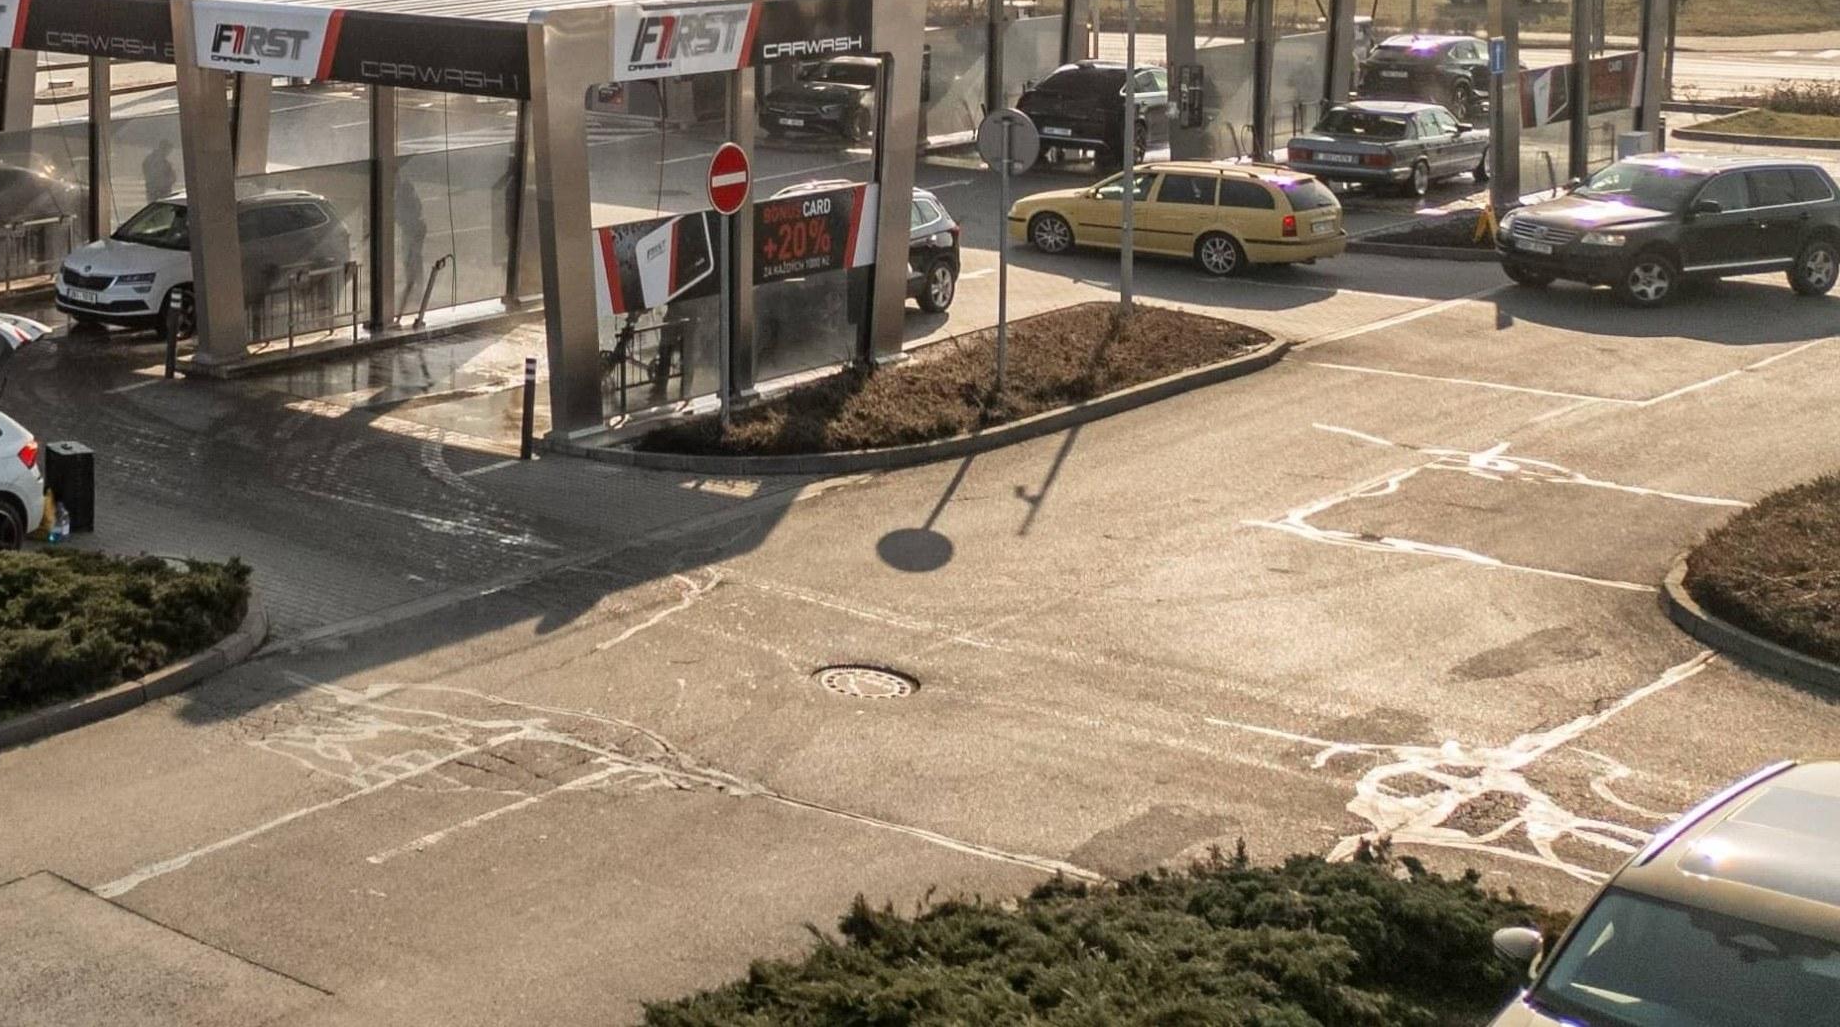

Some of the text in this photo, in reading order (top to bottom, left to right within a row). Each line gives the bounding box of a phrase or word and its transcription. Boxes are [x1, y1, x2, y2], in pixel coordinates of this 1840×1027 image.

[46, 31, 157, 55] CARWASH
[763, 36, 862, 59] CARWASH
[210, 54, 261, 65] CARWASH
[628, 62, 672, 71] CARWASH
[361, 61, 503, 88] CARWASH
[764, 219, 831, 260] +20%
